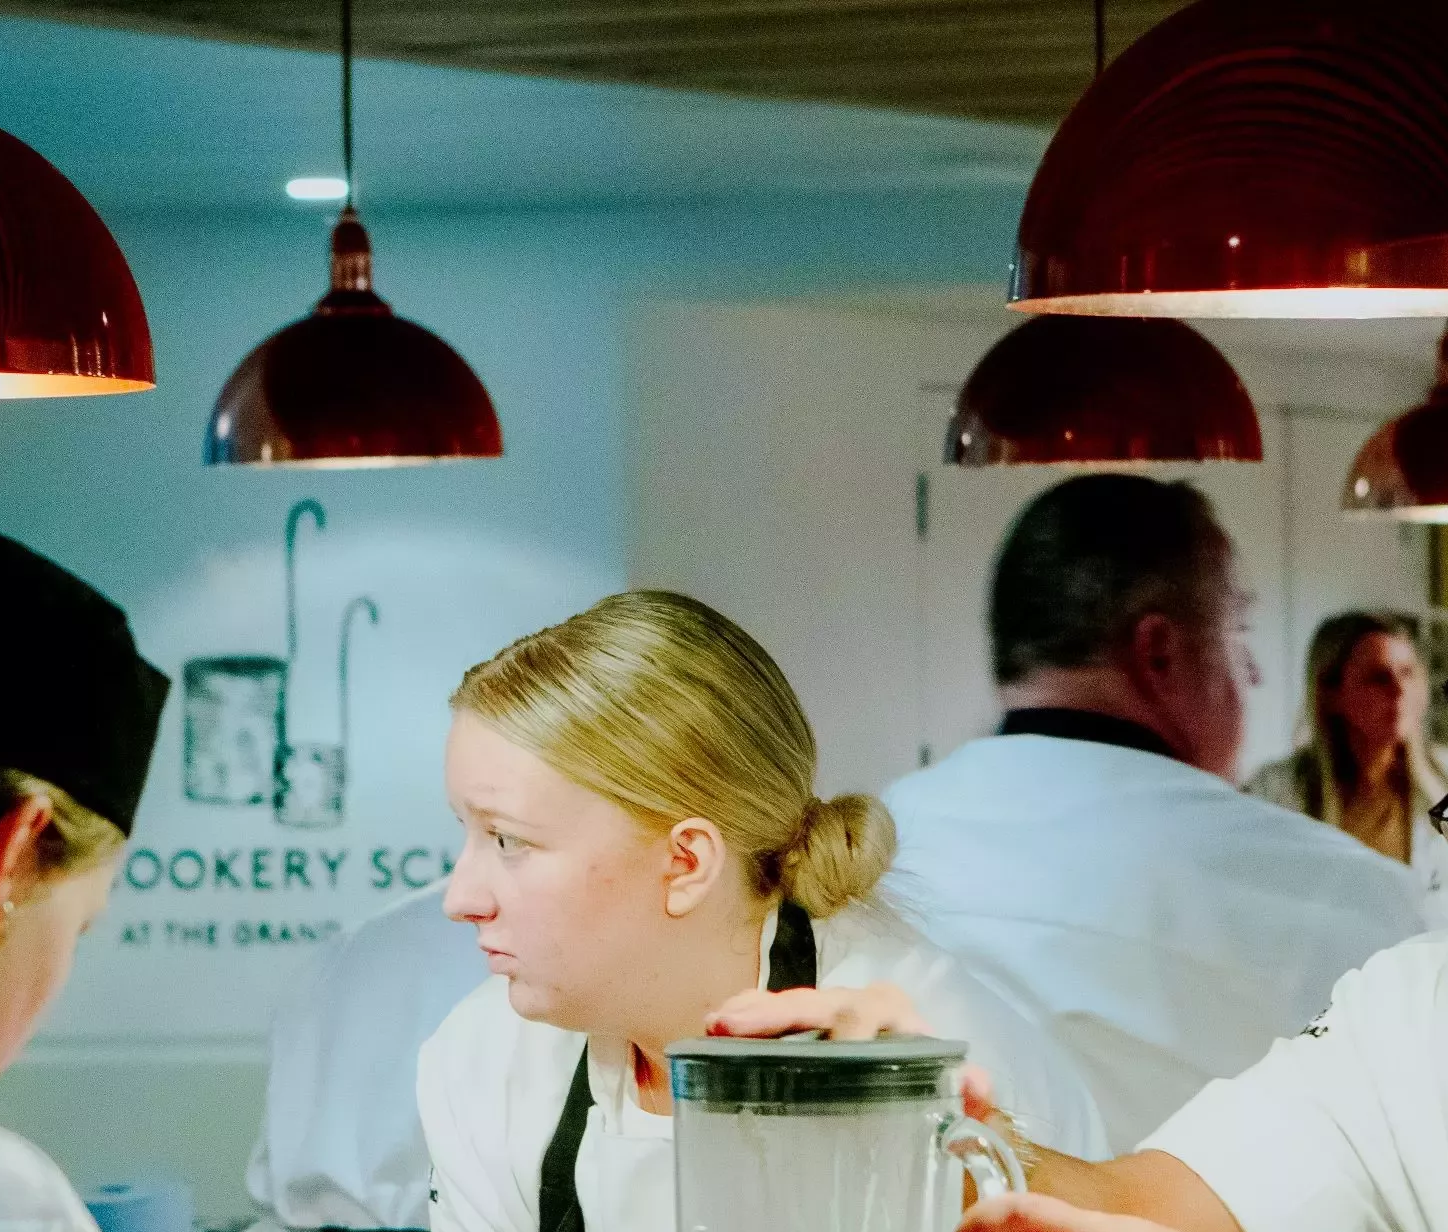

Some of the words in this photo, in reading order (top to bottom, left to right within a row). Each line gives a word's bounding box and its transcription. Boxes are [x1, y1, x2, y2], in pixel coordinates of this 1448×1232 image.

[112, 847, 349, 891] OOKERY
[120, 920, 154, 945] AT
[164, 919, 218, 949] THE
